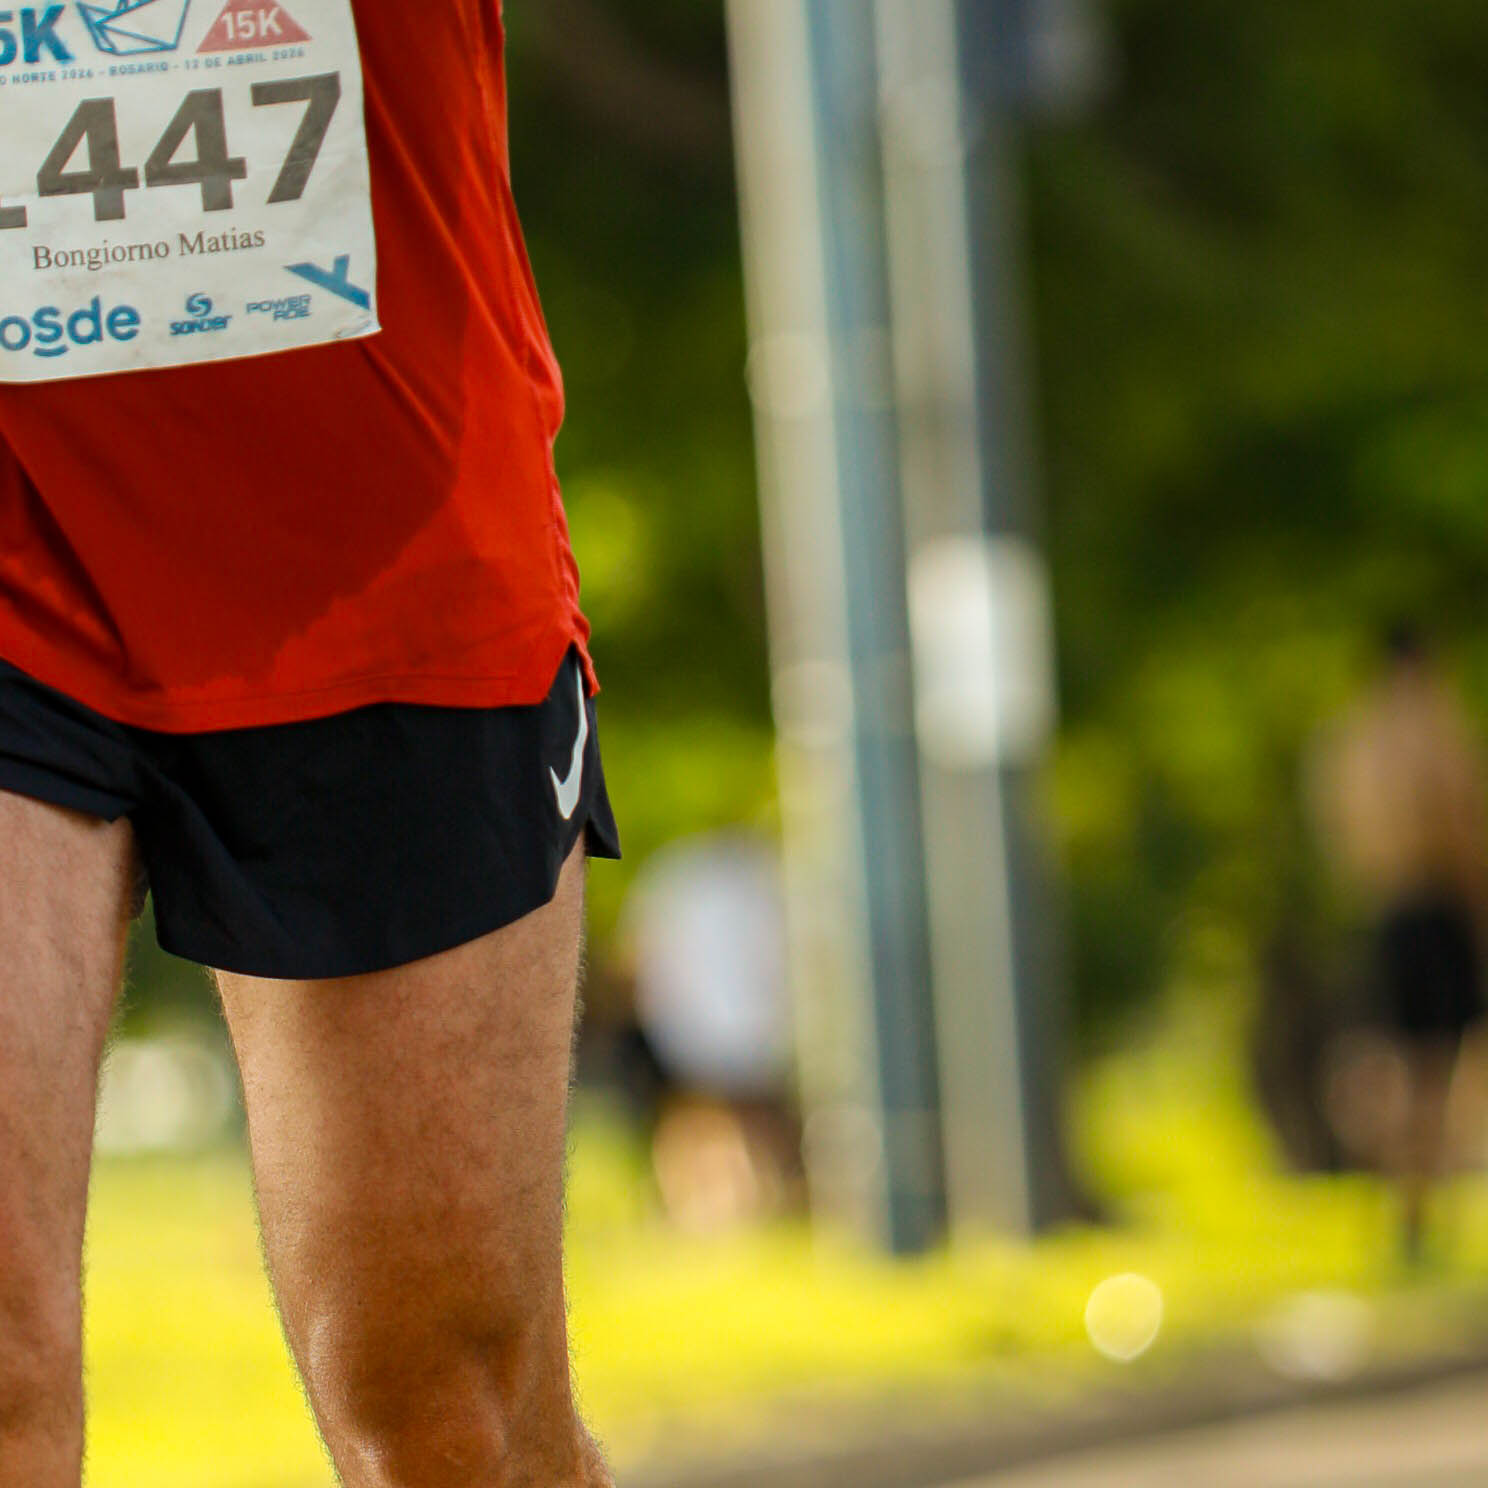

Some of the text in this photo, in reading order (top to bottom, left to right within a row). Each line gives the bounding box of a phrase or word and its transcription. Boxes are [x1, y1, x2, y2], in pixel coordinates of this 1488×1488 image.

[220, 7, 284, 41] 15K
[12, 70, 57, 84] NORTE
[108, 61, 169, 77] ROSARIO
[205, 56, 222, 68] DE
[226, 52, 267, 67] ABRIL
[31, 227, 266, 272] Bongiorno Matias
[245, 294, 312, 314] POWER
